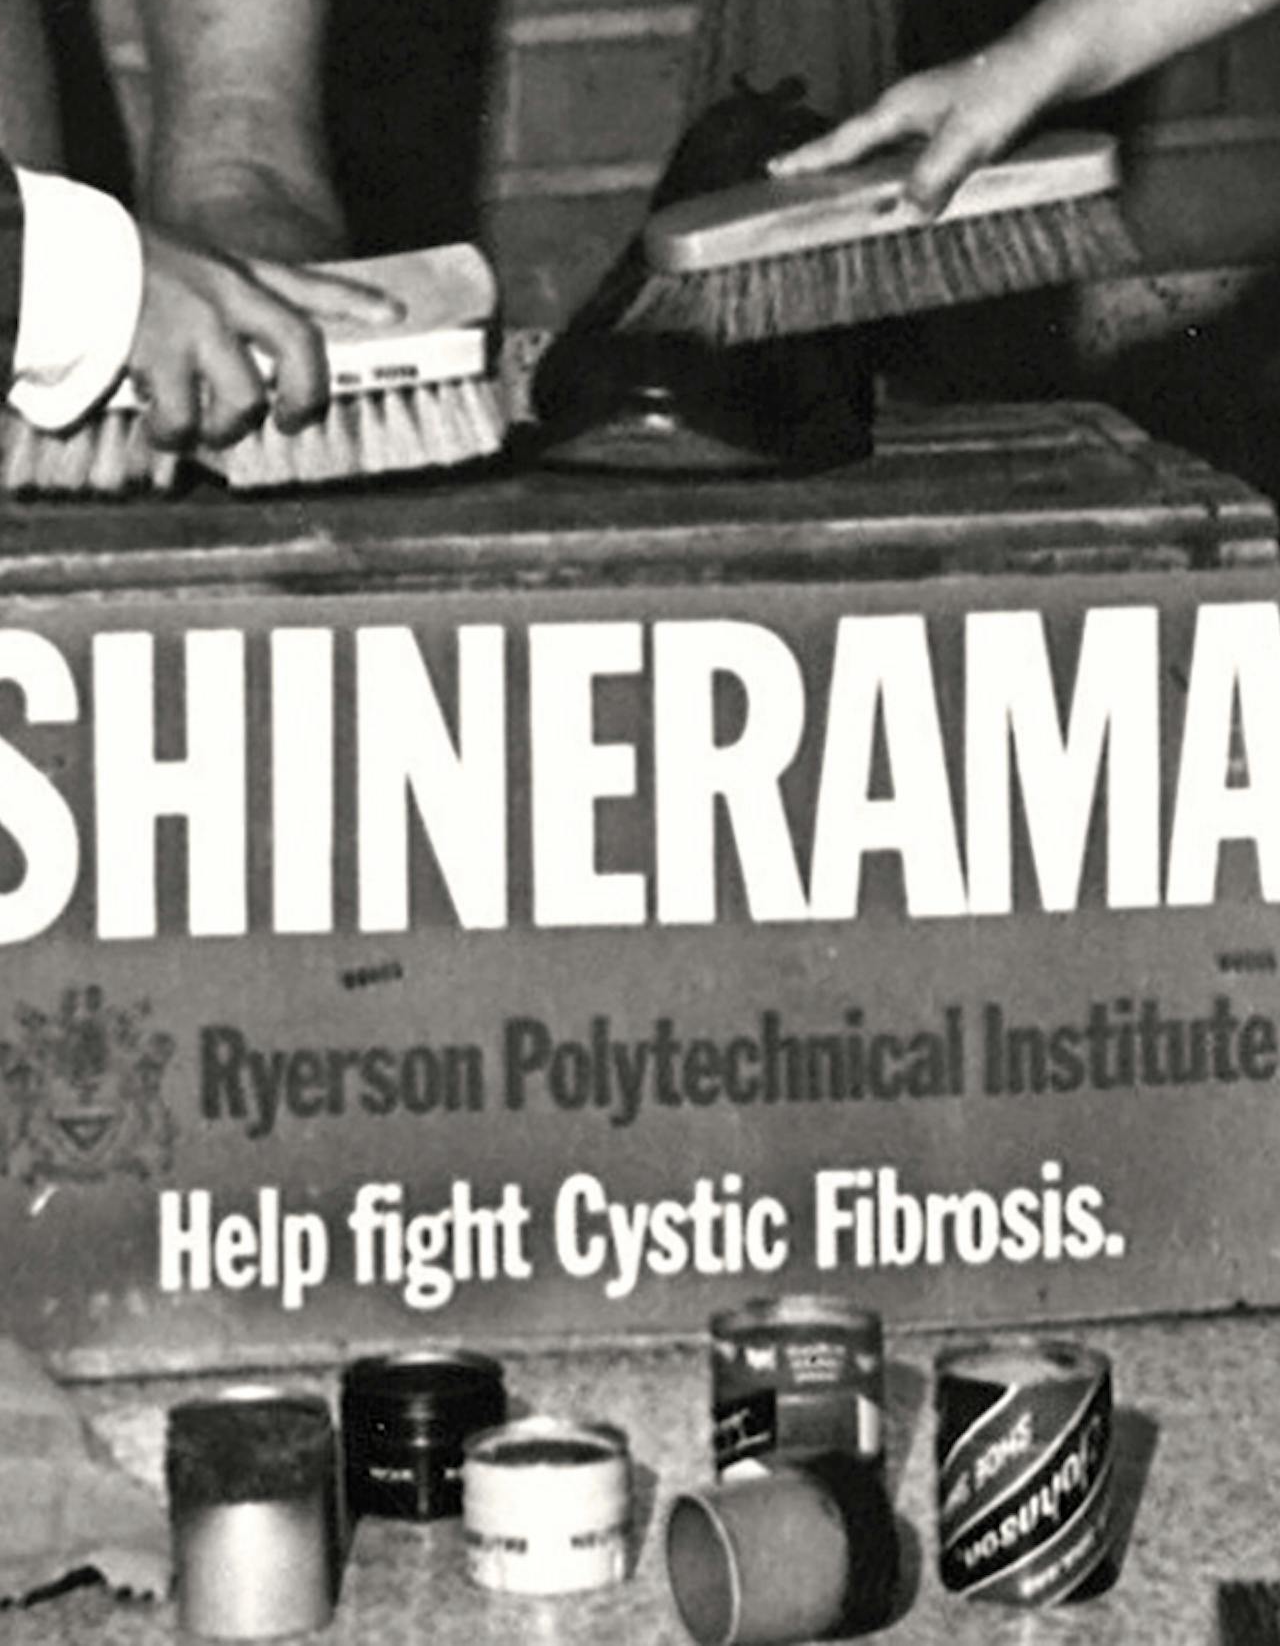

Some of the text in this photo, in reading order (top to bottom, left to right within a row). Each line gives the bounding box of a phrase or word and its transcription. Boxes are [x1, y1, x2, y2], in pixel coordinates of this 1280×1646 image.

[199, 995, 1279, 1140] Ryerson Polytechnical Institute
[160, 1161, 1125, 1309] Help fight Cystic Fibrosis.
